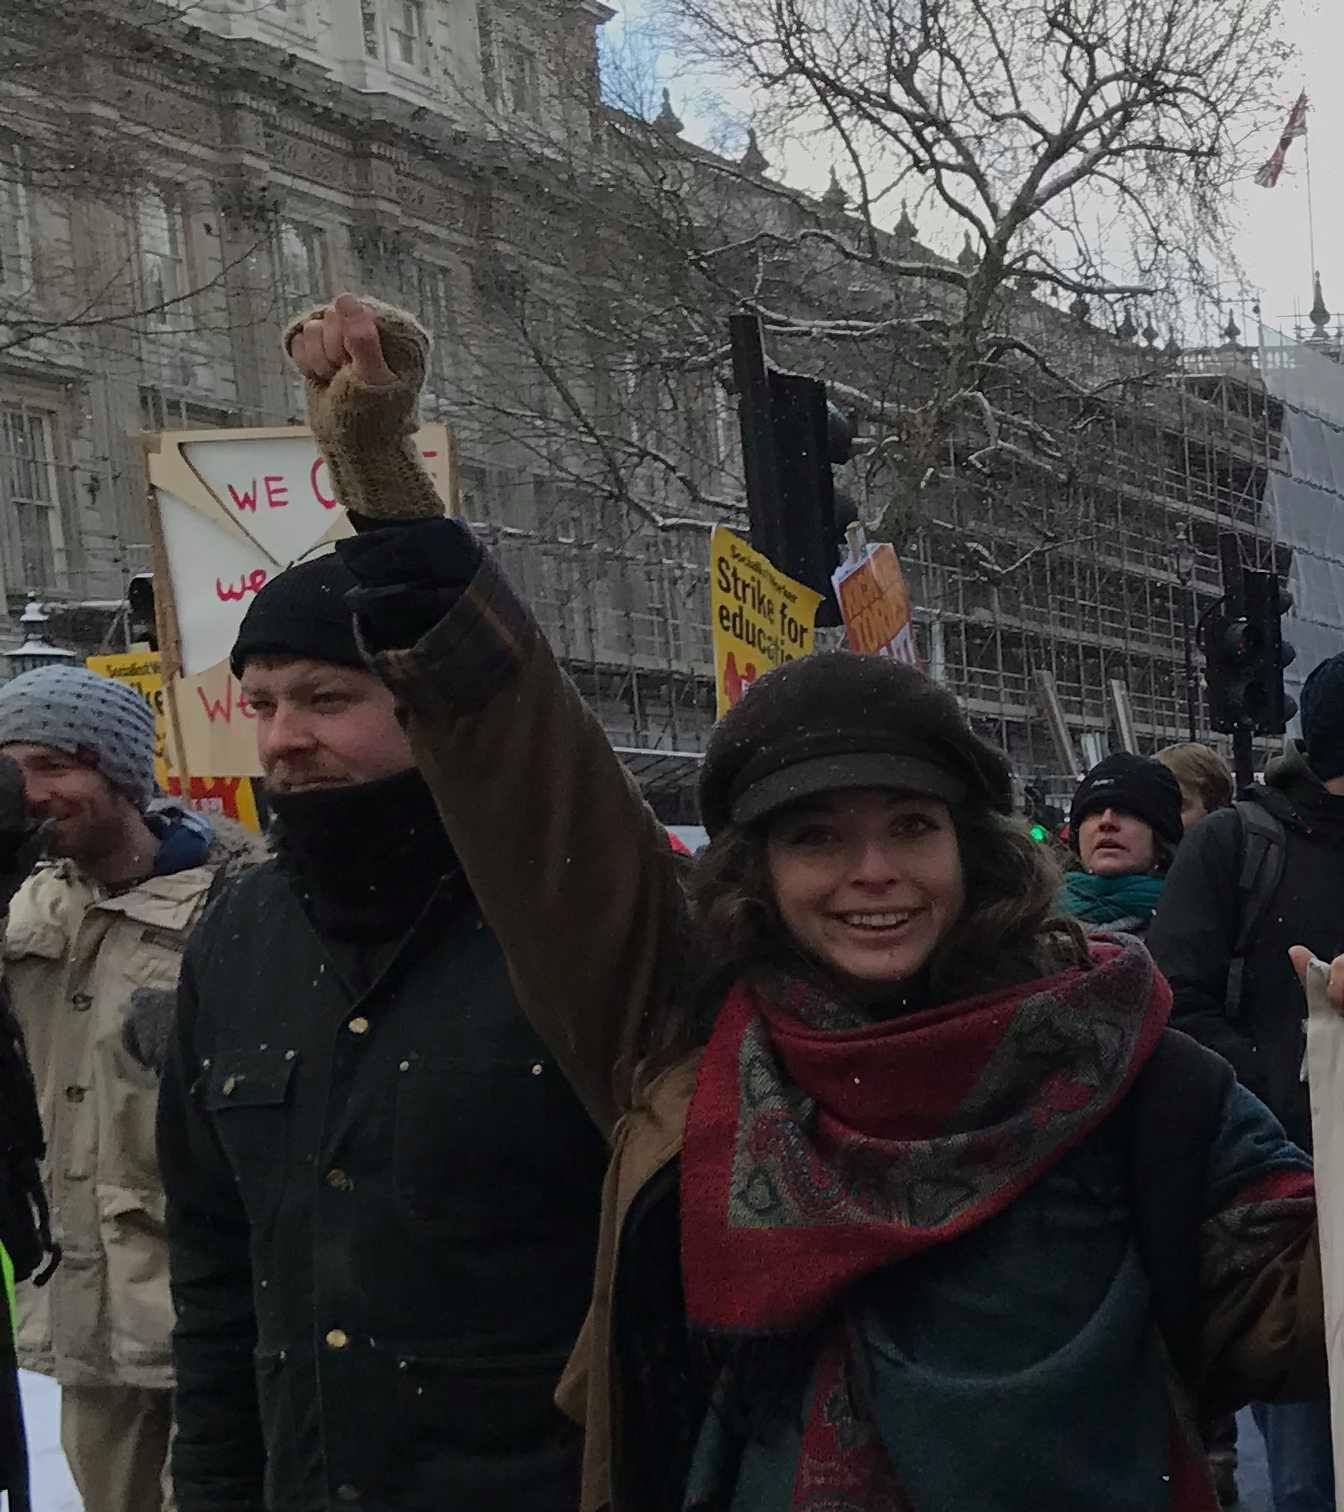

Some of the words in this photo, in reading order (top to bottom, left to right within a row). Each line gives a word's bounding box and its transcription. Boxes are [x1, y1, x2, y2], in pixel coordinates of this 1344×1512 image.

[228, 475, 290, 513] WE
[717, 556, 776, 625] Strike
[779, 602, 809, 649] for
